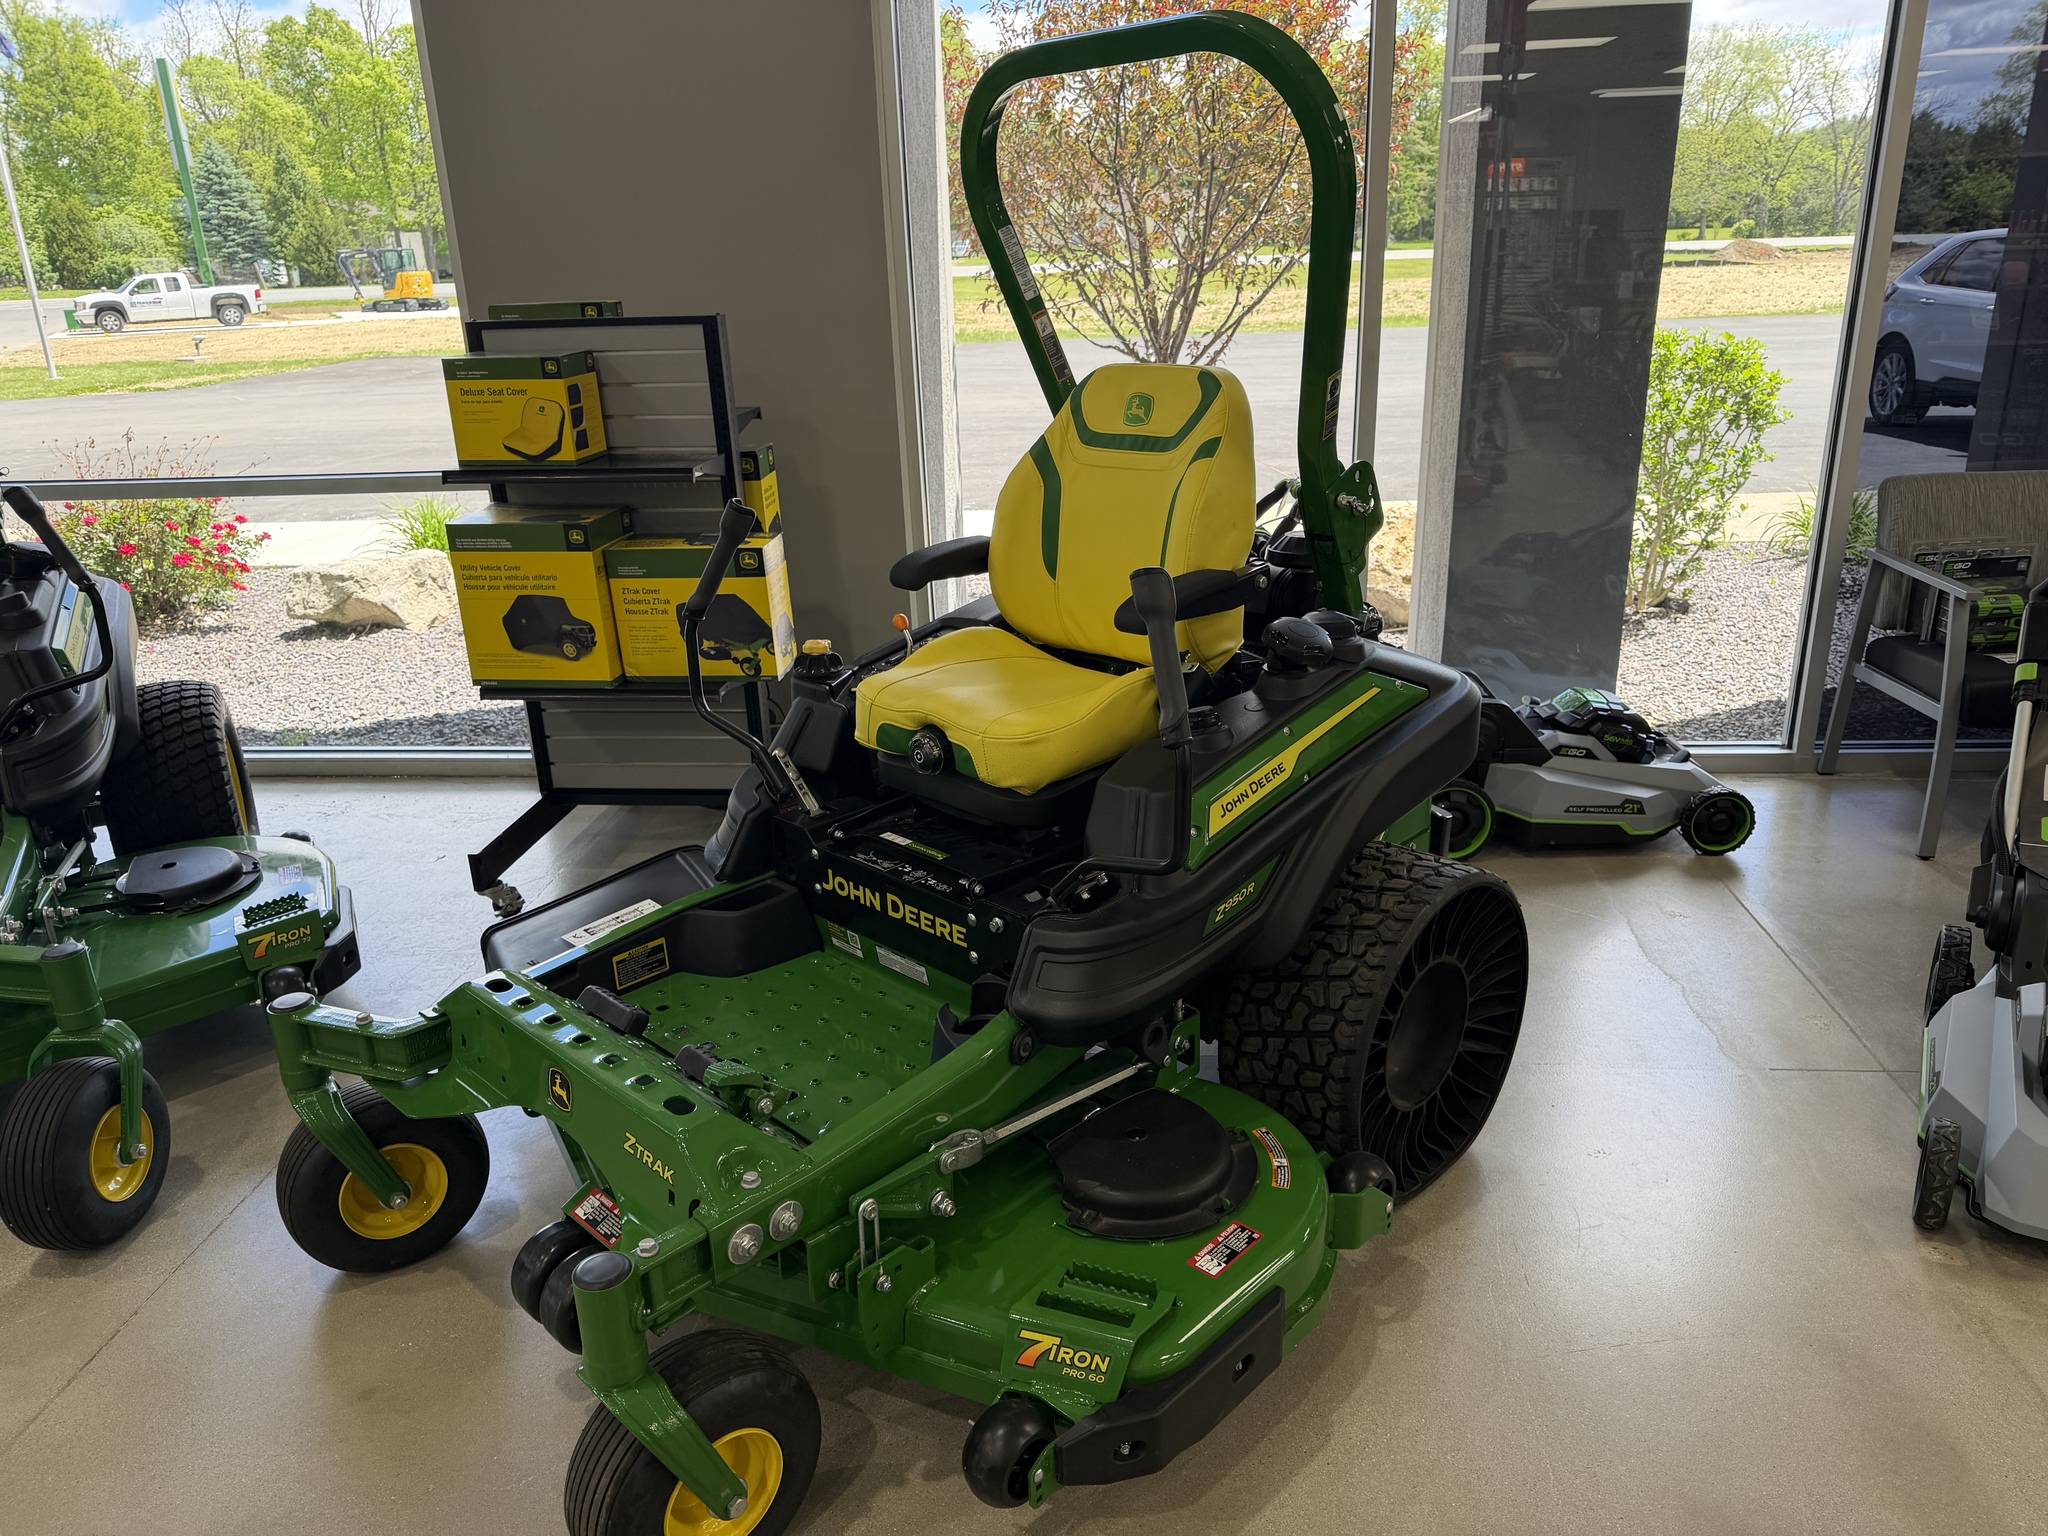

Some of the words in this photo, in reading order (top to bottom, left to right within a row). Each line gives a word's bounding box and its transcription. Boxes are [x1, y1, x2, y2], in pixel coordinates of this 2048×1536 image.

[459, 387, 485, 397] Deluxe
[487, 387, 504, 396] Seat
[506, 387, 528, 396] Cover
[460, 564, 478, 572] Utility
[621, 587, 640, 595] ZTrak
[641, 587, 660, 595] Cover
[623, 597, 651, 605] Cubierta
[652, 597, 671, 605] ZTrak
[650, 607, 669, 615] ZTrak
[1559, 747, 1587, 756] EGO
[1219, 789, 1250, 818] JOHN
[1249, 761, 1287, 796] DEERE
[1214, 881, 1255, 922] Z950R
[822, 868, 881, 912] JOHN
[886, 892, 968, 948] DEERE
[284, 940, 300, 949] PRO
[623, 1131, 675, 1185] ZTRAK
[1062, 1367, 1086, 1379] PRO
[1088, 1373, 1105, 1384] 60
